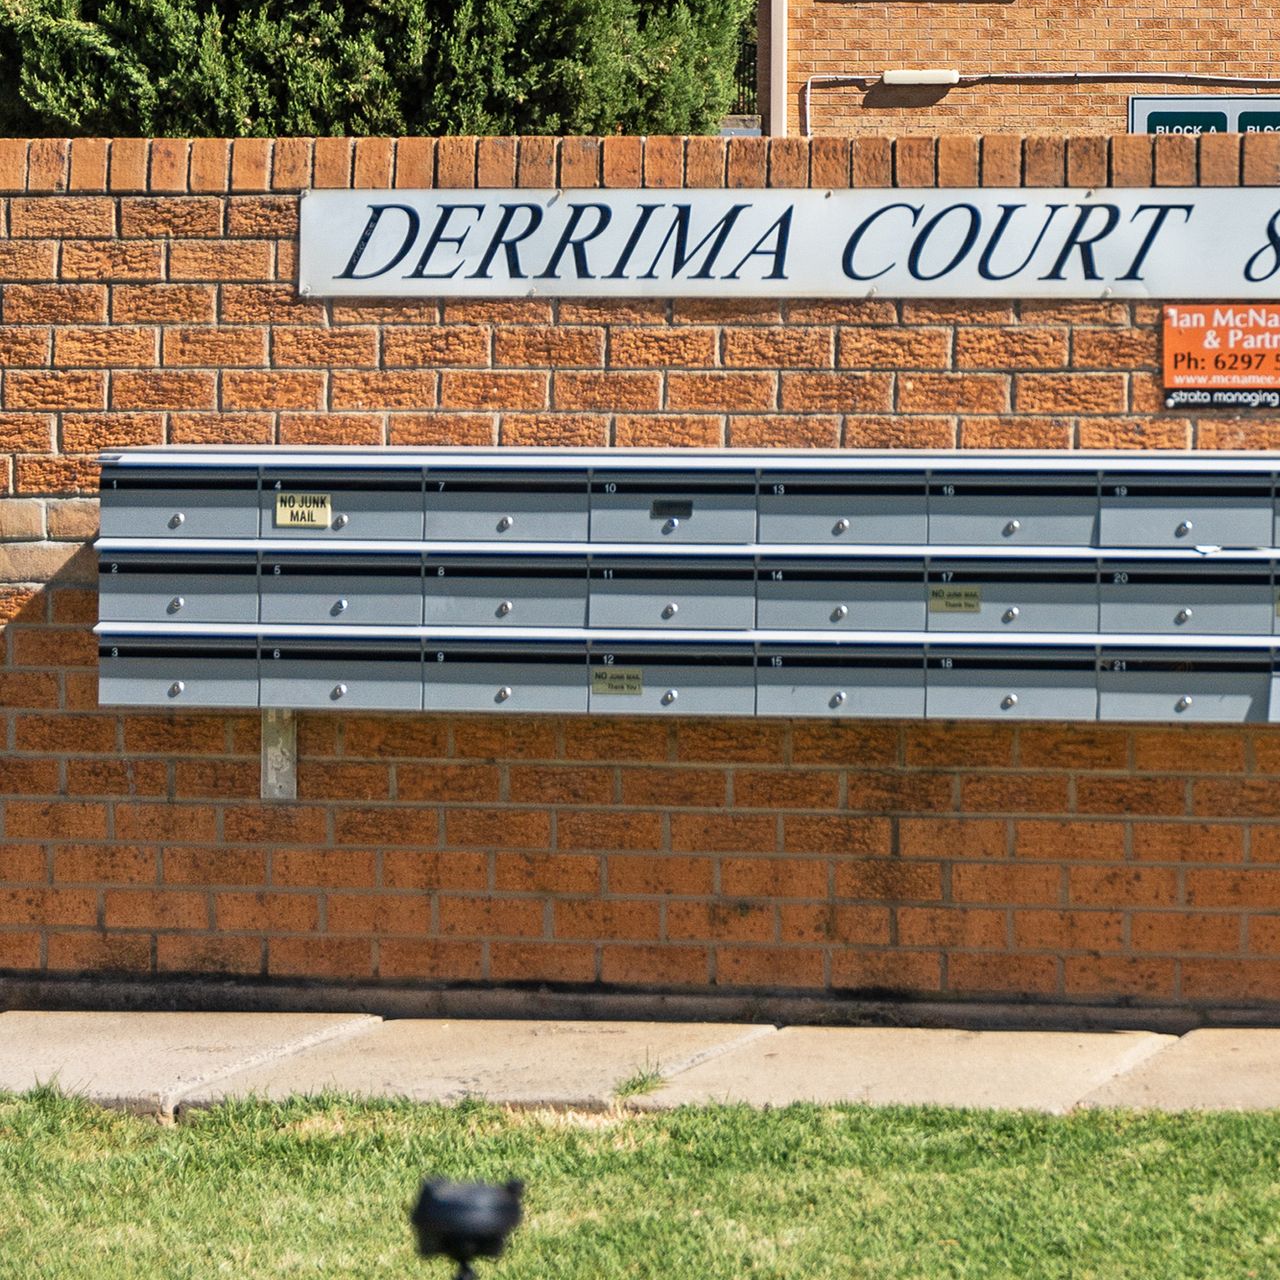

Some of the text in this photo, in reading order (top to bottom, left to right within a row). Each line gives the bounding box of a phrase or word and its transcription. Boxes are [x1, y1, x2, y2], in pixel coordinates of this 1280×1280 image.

[1156, 125, 1218, 135] BLOCK A
[332, 203, 794, 280] DERRIMA
[841, 203, 1195, 281] COURT
[1170, 308, 1205, 328] Ian
[1203, 330, 1220, 349] &
[1173, 352, 1206, 370] Ph:
[1214, 353, 1266, 371] 6297
[1172, 390, 1211, 403] strata
[1213, 390, 1280, 407] managing
[112, 479, 117, 490] 1
[274, 480, 282, 491] 4
[439, 481, 445, 492] 7
[605, 483, 617, 494] 10
[773, 484, 785, 495] 13
[943, 485, 955, 496] 16
[1115, 486, 1127, 497] 19
[280, 495, 327, 508] NO JUNK
[290, 510, 316, 522] MAIL
[111, 563, 118, 574] 2
[274, 564, 281, 576] 5
[438, 566, 445, 577] 8
[603, 569, 613, 580] 11
[772, 570, 783, 581] 14
[942, 571, 953, 582] 17
[1114, 572, 1128, 583] 20
[111, 647, 119, 658] 3
[273, 649, 280, 660] 6
[437, 651, 444, 662] 9
[603, 654, 614, 665] 12
[771, 656, 783, 667] 15
[941, 658, 953, 669] 18
[1114, 660, 1126, 671] 21
[594, 671, 608, 680] NO
